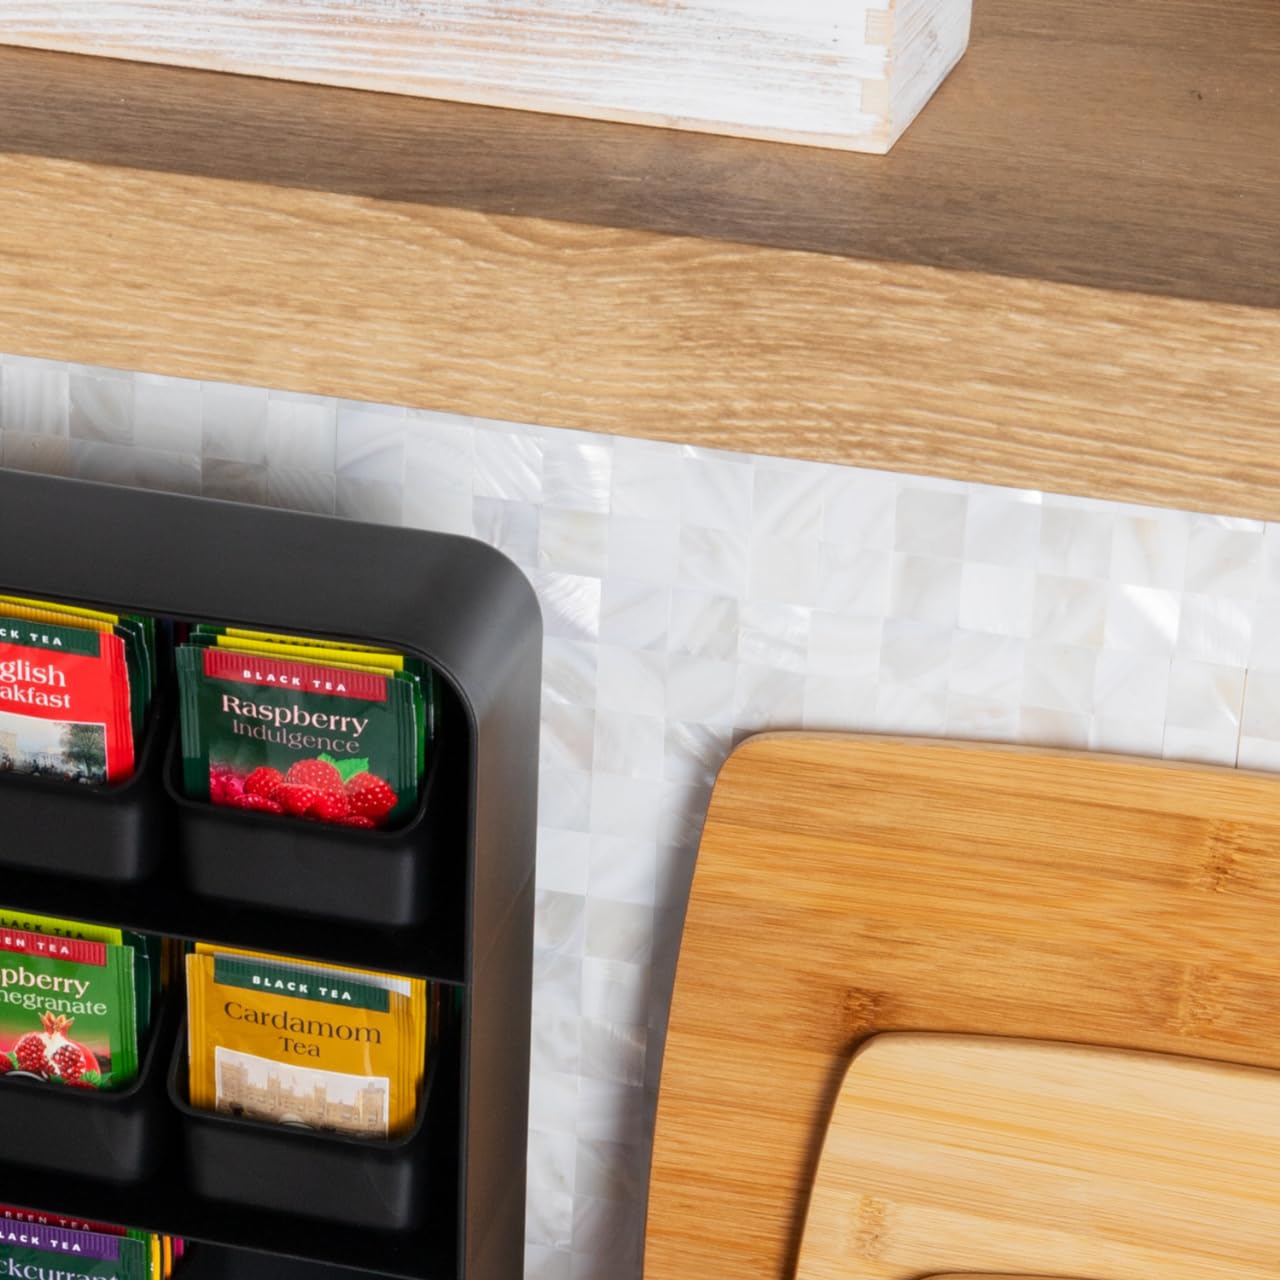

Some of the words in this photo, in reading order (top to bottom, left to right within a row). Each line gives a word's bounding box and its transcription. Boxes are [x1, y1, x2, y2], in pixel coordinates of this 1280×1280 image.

[30, 633, 62, 646] TEA
[243, 670, 300, 686] BLACK
[312, 680, 346, 692] TEA
[222, 694, 368, 737] Raspberry
[233, 719, 360, 753] Indulgence
[37, 941, 70, 955] TEA
[252, 975, 309, 994] BLACK
[319, 987, 352, 1000] TEA
[224, 1001, 381, 1044] Cardamom
[278, 1035, 321, 1058] Tea
[59, 1219, 91, 1231] TEA
[50, 1239, 82, 1252] TEA
